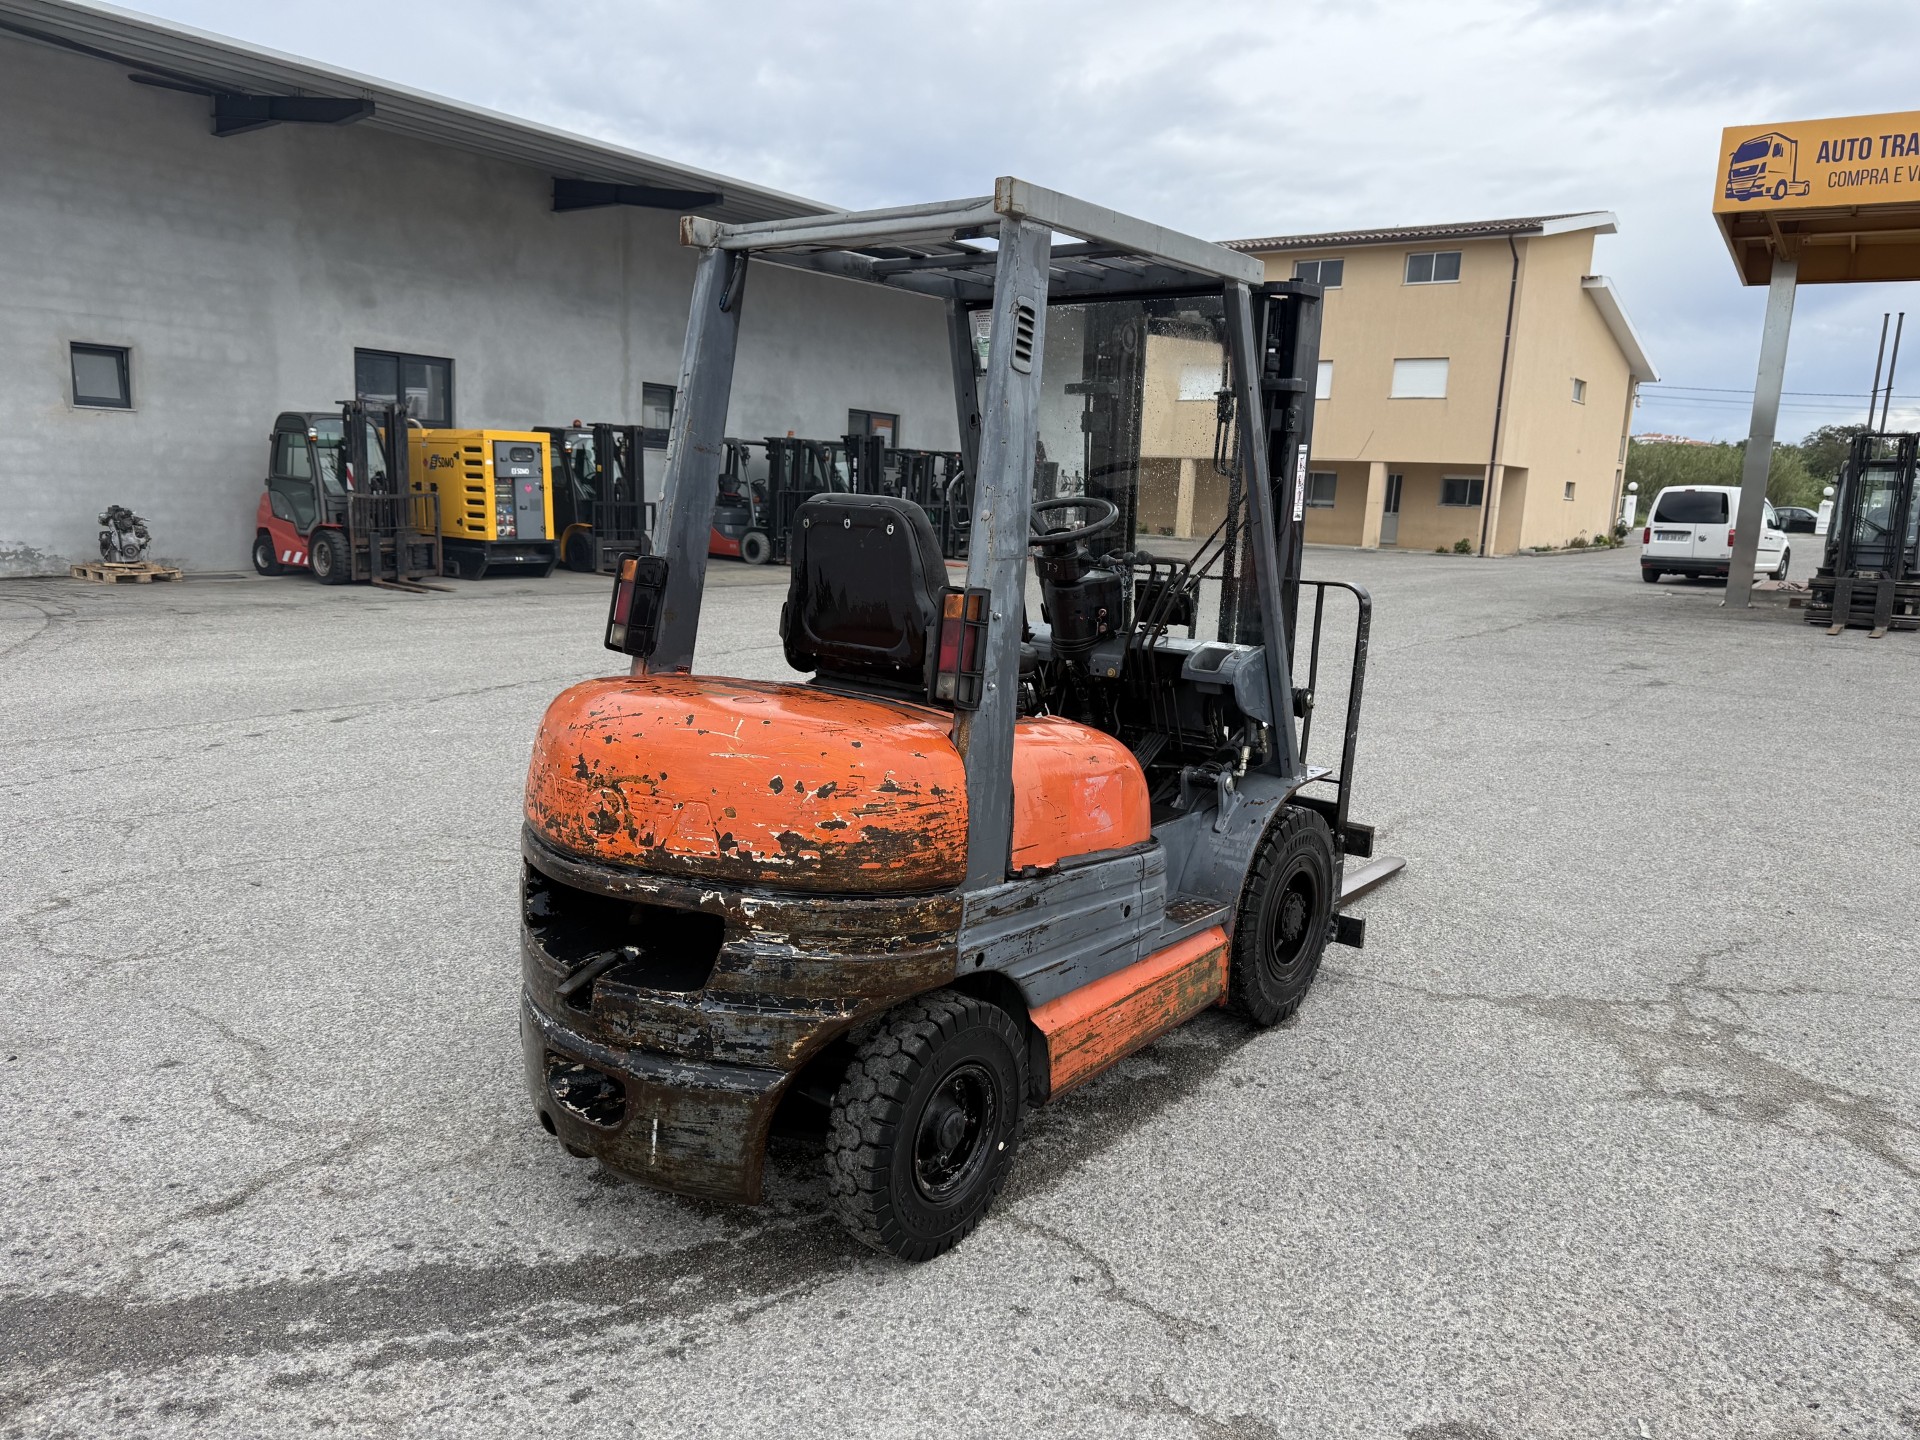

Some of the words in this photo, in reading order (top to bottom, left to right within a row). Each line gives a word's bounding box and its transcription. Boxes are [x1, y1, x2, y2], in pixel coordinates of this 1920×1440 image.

[1816, 136, 1873, 163] AUTO
[1879, 132, 1920, 158] TRA
[1828, 167, 1889, 188] COMPRA
[1893, 166, 1904, 183] E
[1908, 164, 1920, 182] V
